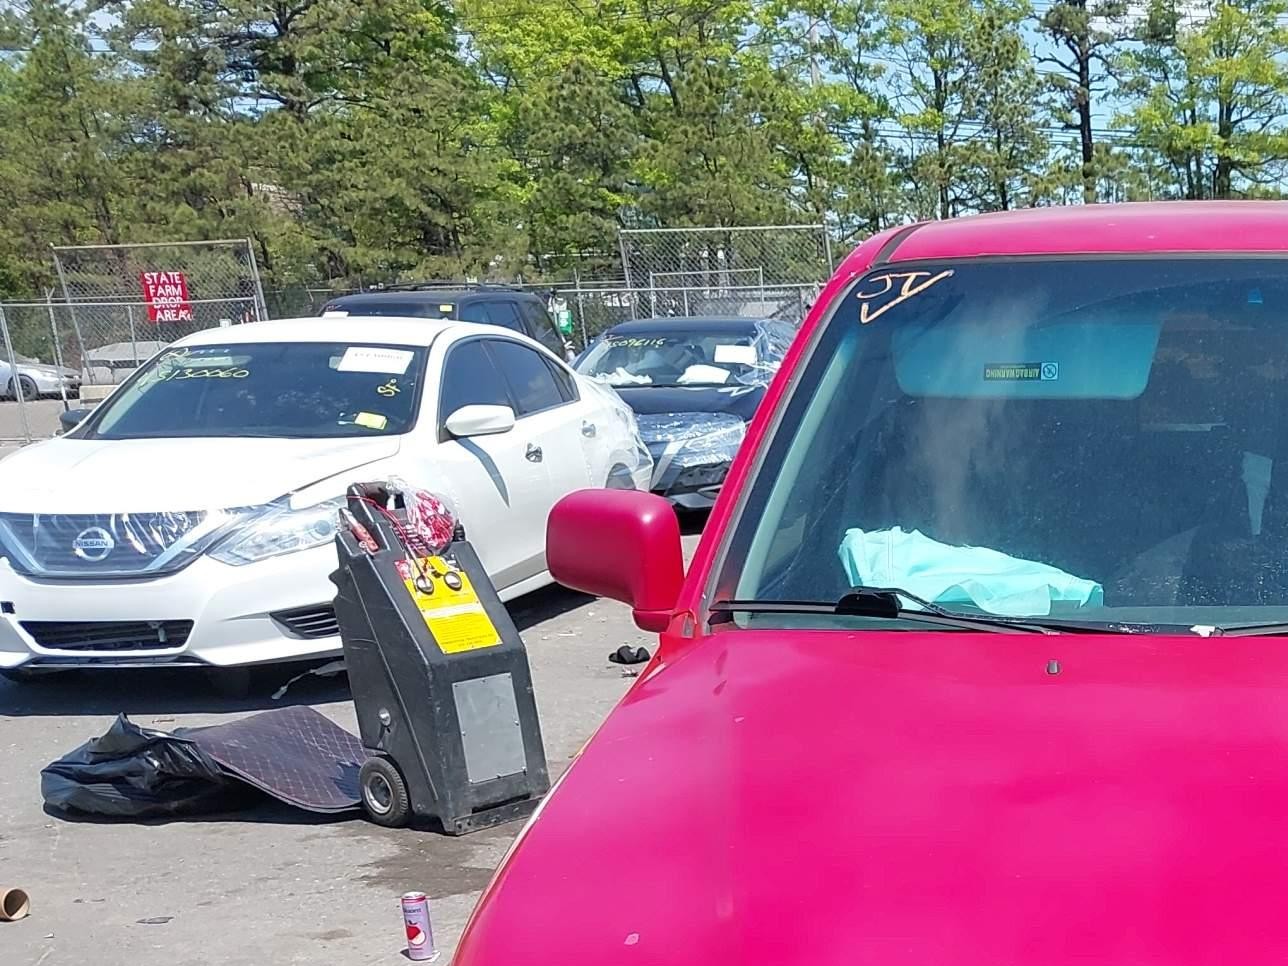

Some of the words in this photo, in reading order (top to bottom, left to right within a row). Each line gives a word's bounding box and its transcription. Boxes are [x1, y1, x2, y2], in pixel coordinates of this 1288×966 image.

[143, 271, 182, 285] STATE
[149, 284, 183, 297] FARM
[152, 296, 183, 309] DROP
[156, 309, 188, 321] AREA
